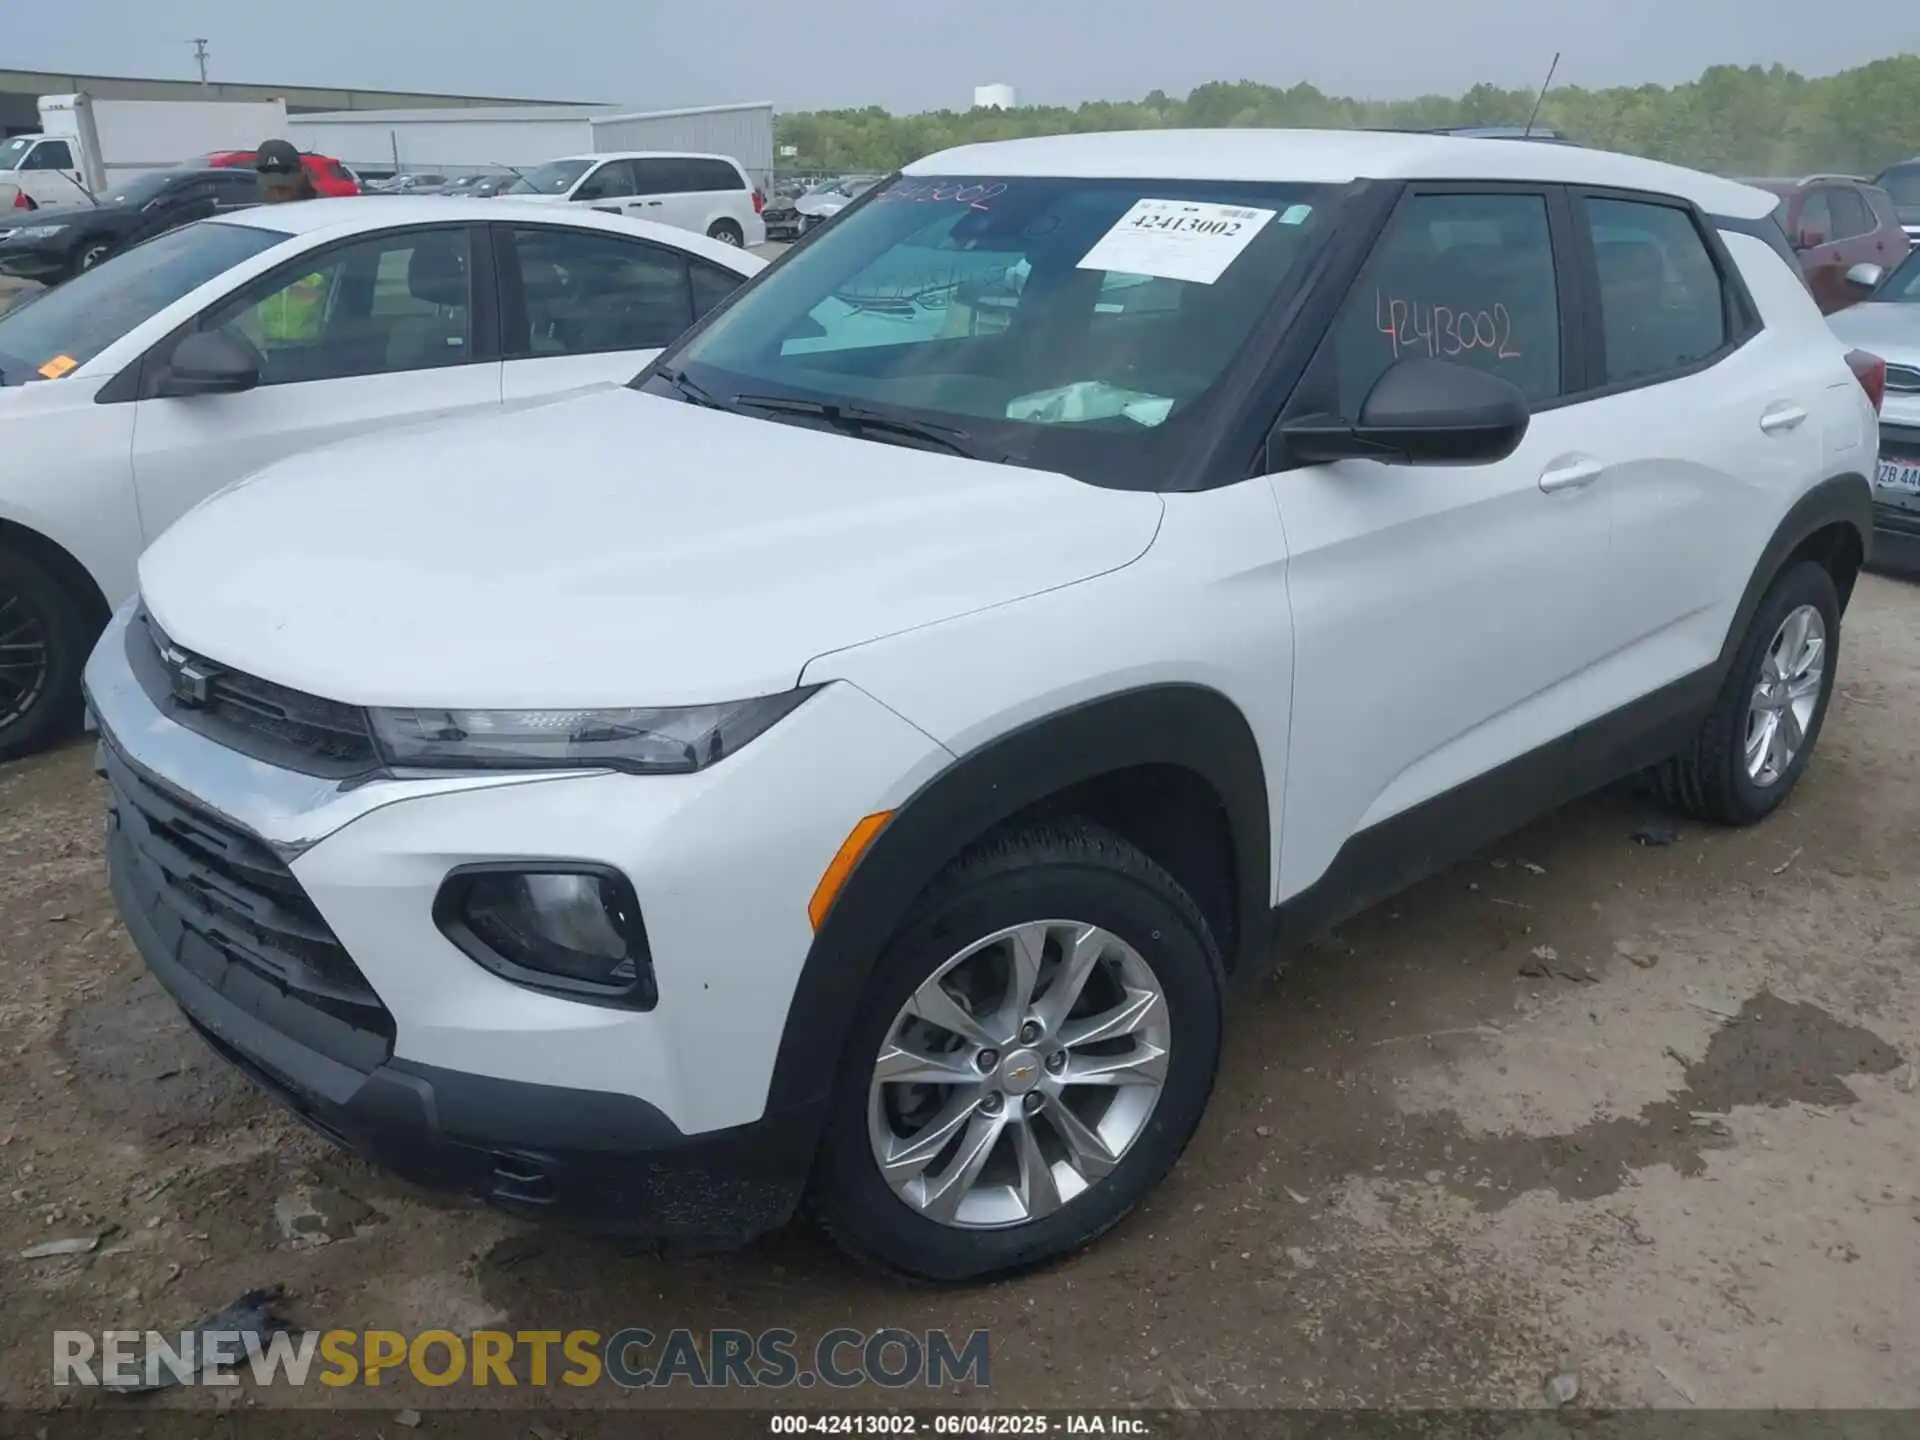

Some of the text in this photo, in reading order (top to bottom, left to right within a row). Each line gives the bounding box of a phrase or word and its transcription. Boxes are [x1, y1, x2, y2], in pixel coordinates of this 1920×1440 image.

[1131, 214, 1242, 237] 42413002
[1375, 286, 1521, 359] 42413002
[1878, 464, 1898, 483] ZB
